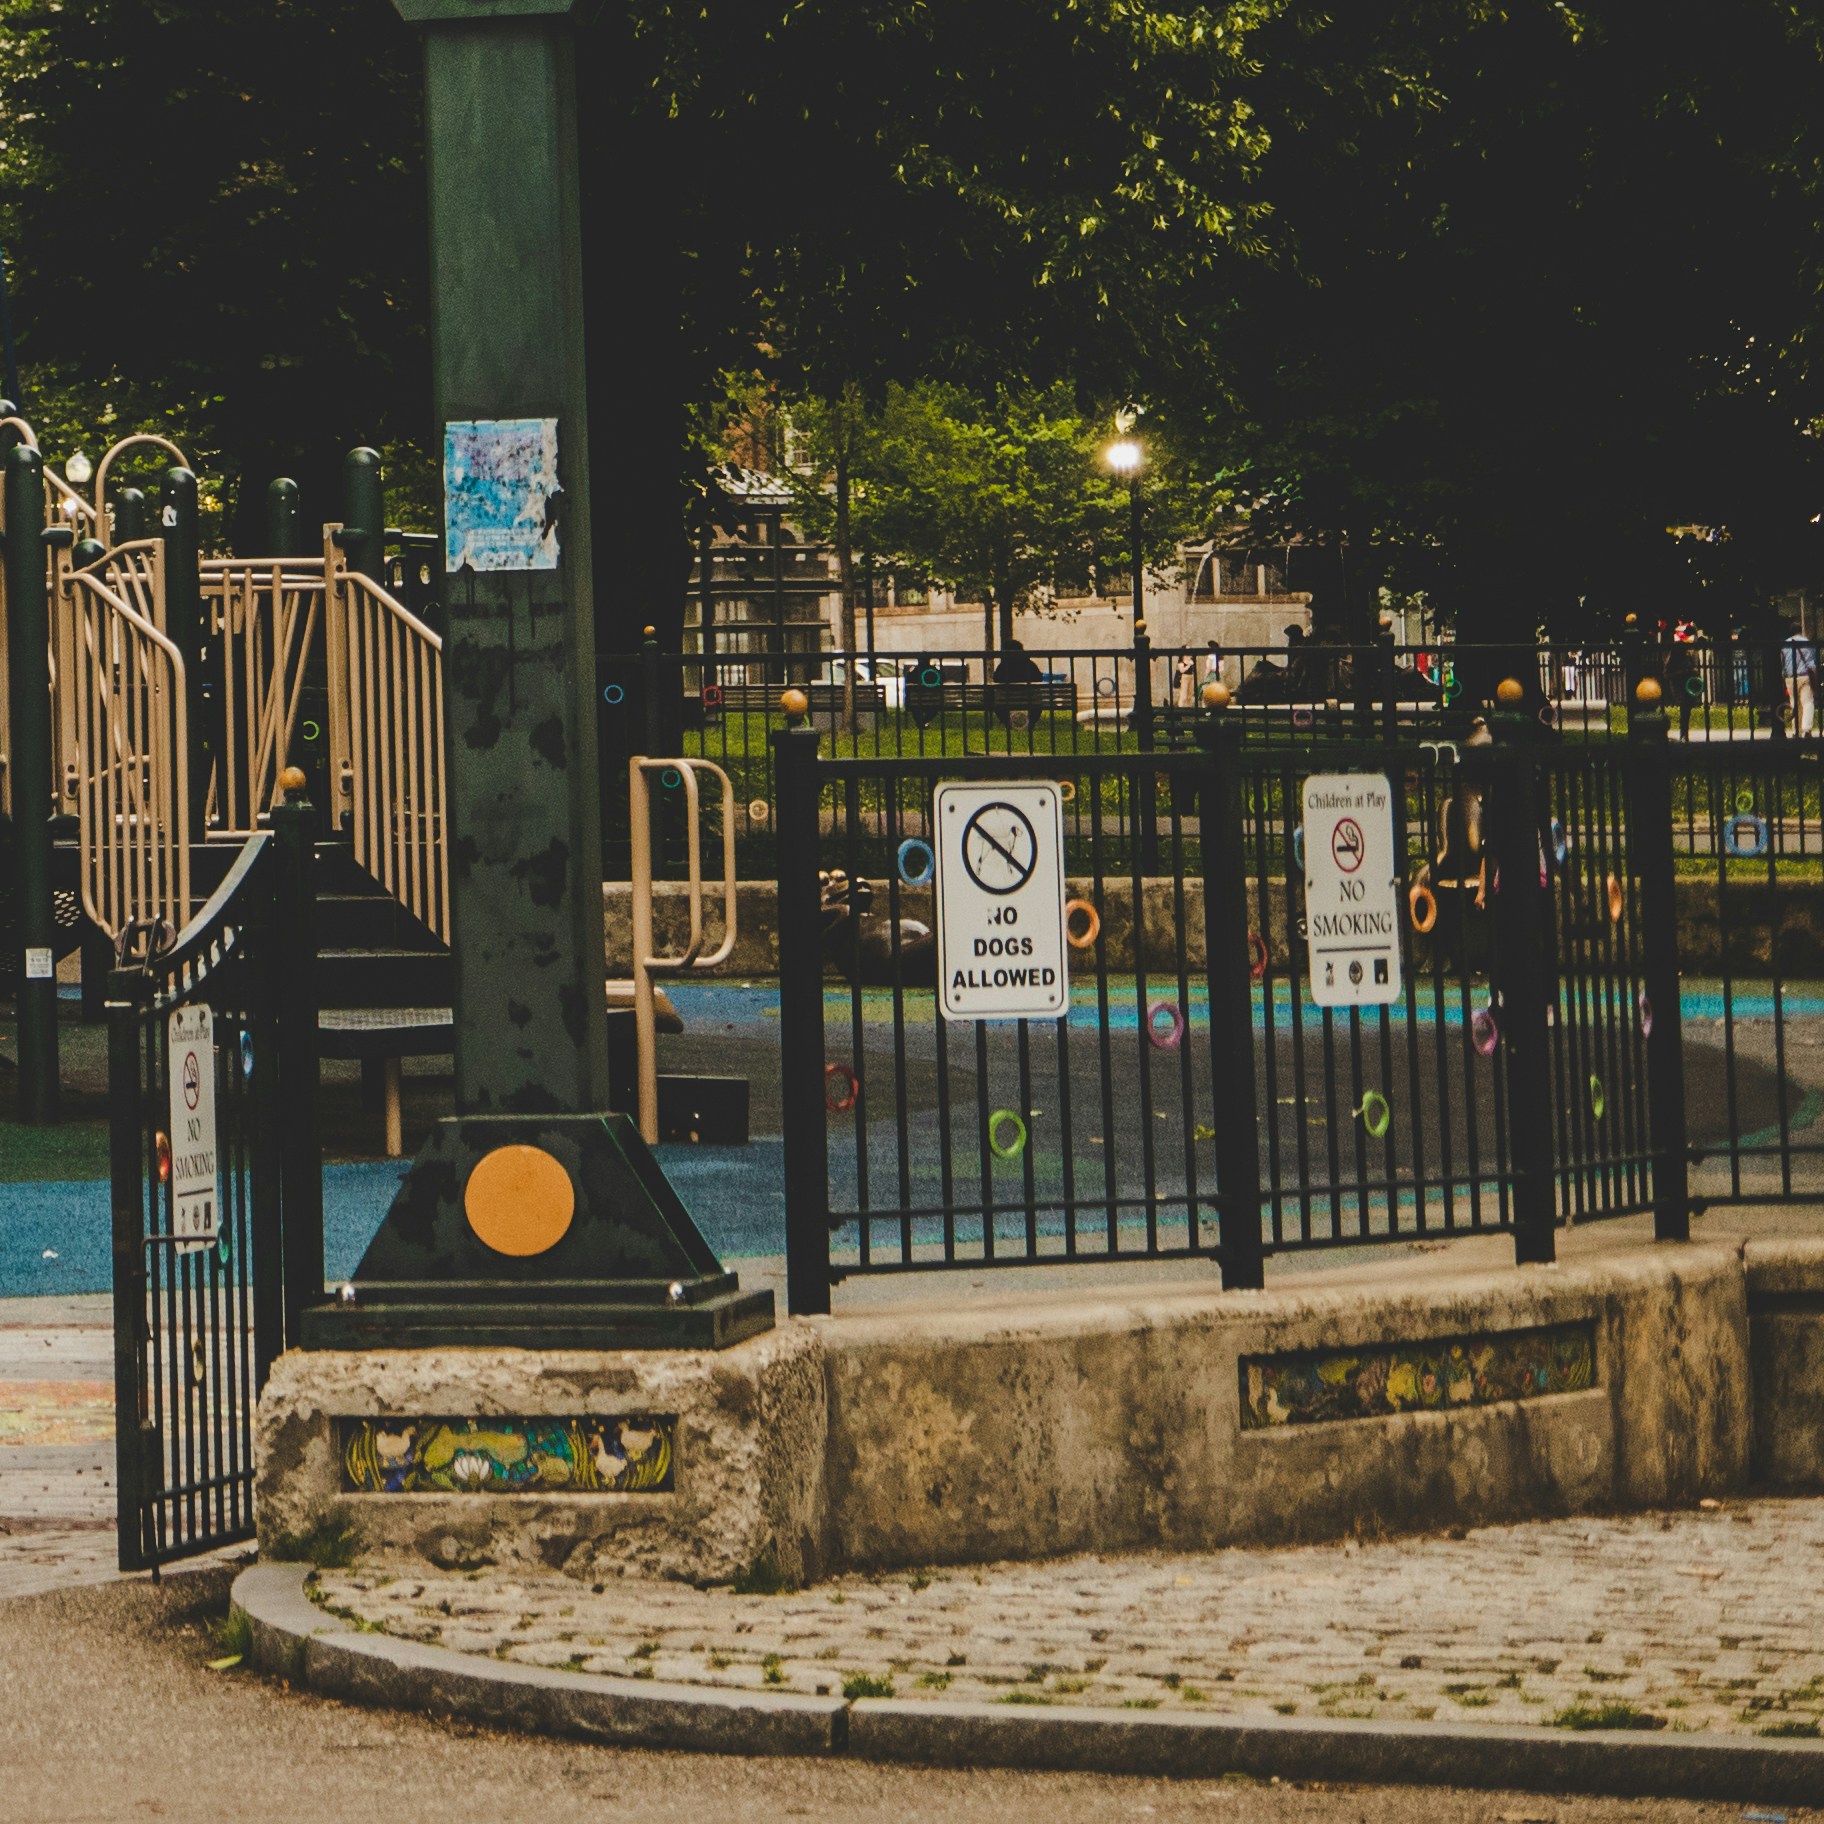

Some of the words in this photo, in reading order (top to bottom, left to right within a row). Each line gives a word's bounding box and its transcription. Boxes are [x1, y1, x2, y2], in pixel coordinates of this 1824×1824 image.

[1308, 793, 1351, 809] Children
[1354, 794, 1364, 808] at
[1367, 792, 1386, 810] Play
[1340, 879, 1365, 902] NO
[1313, 912, 1392, 937] SMOKING
[974, 938, 1033, 956] DOGS
[953, 968, 1055, 988] ALLOWED
[188, 1118, 200, 1142] NO
[175, 1151, 214, 1180] SMOKING
